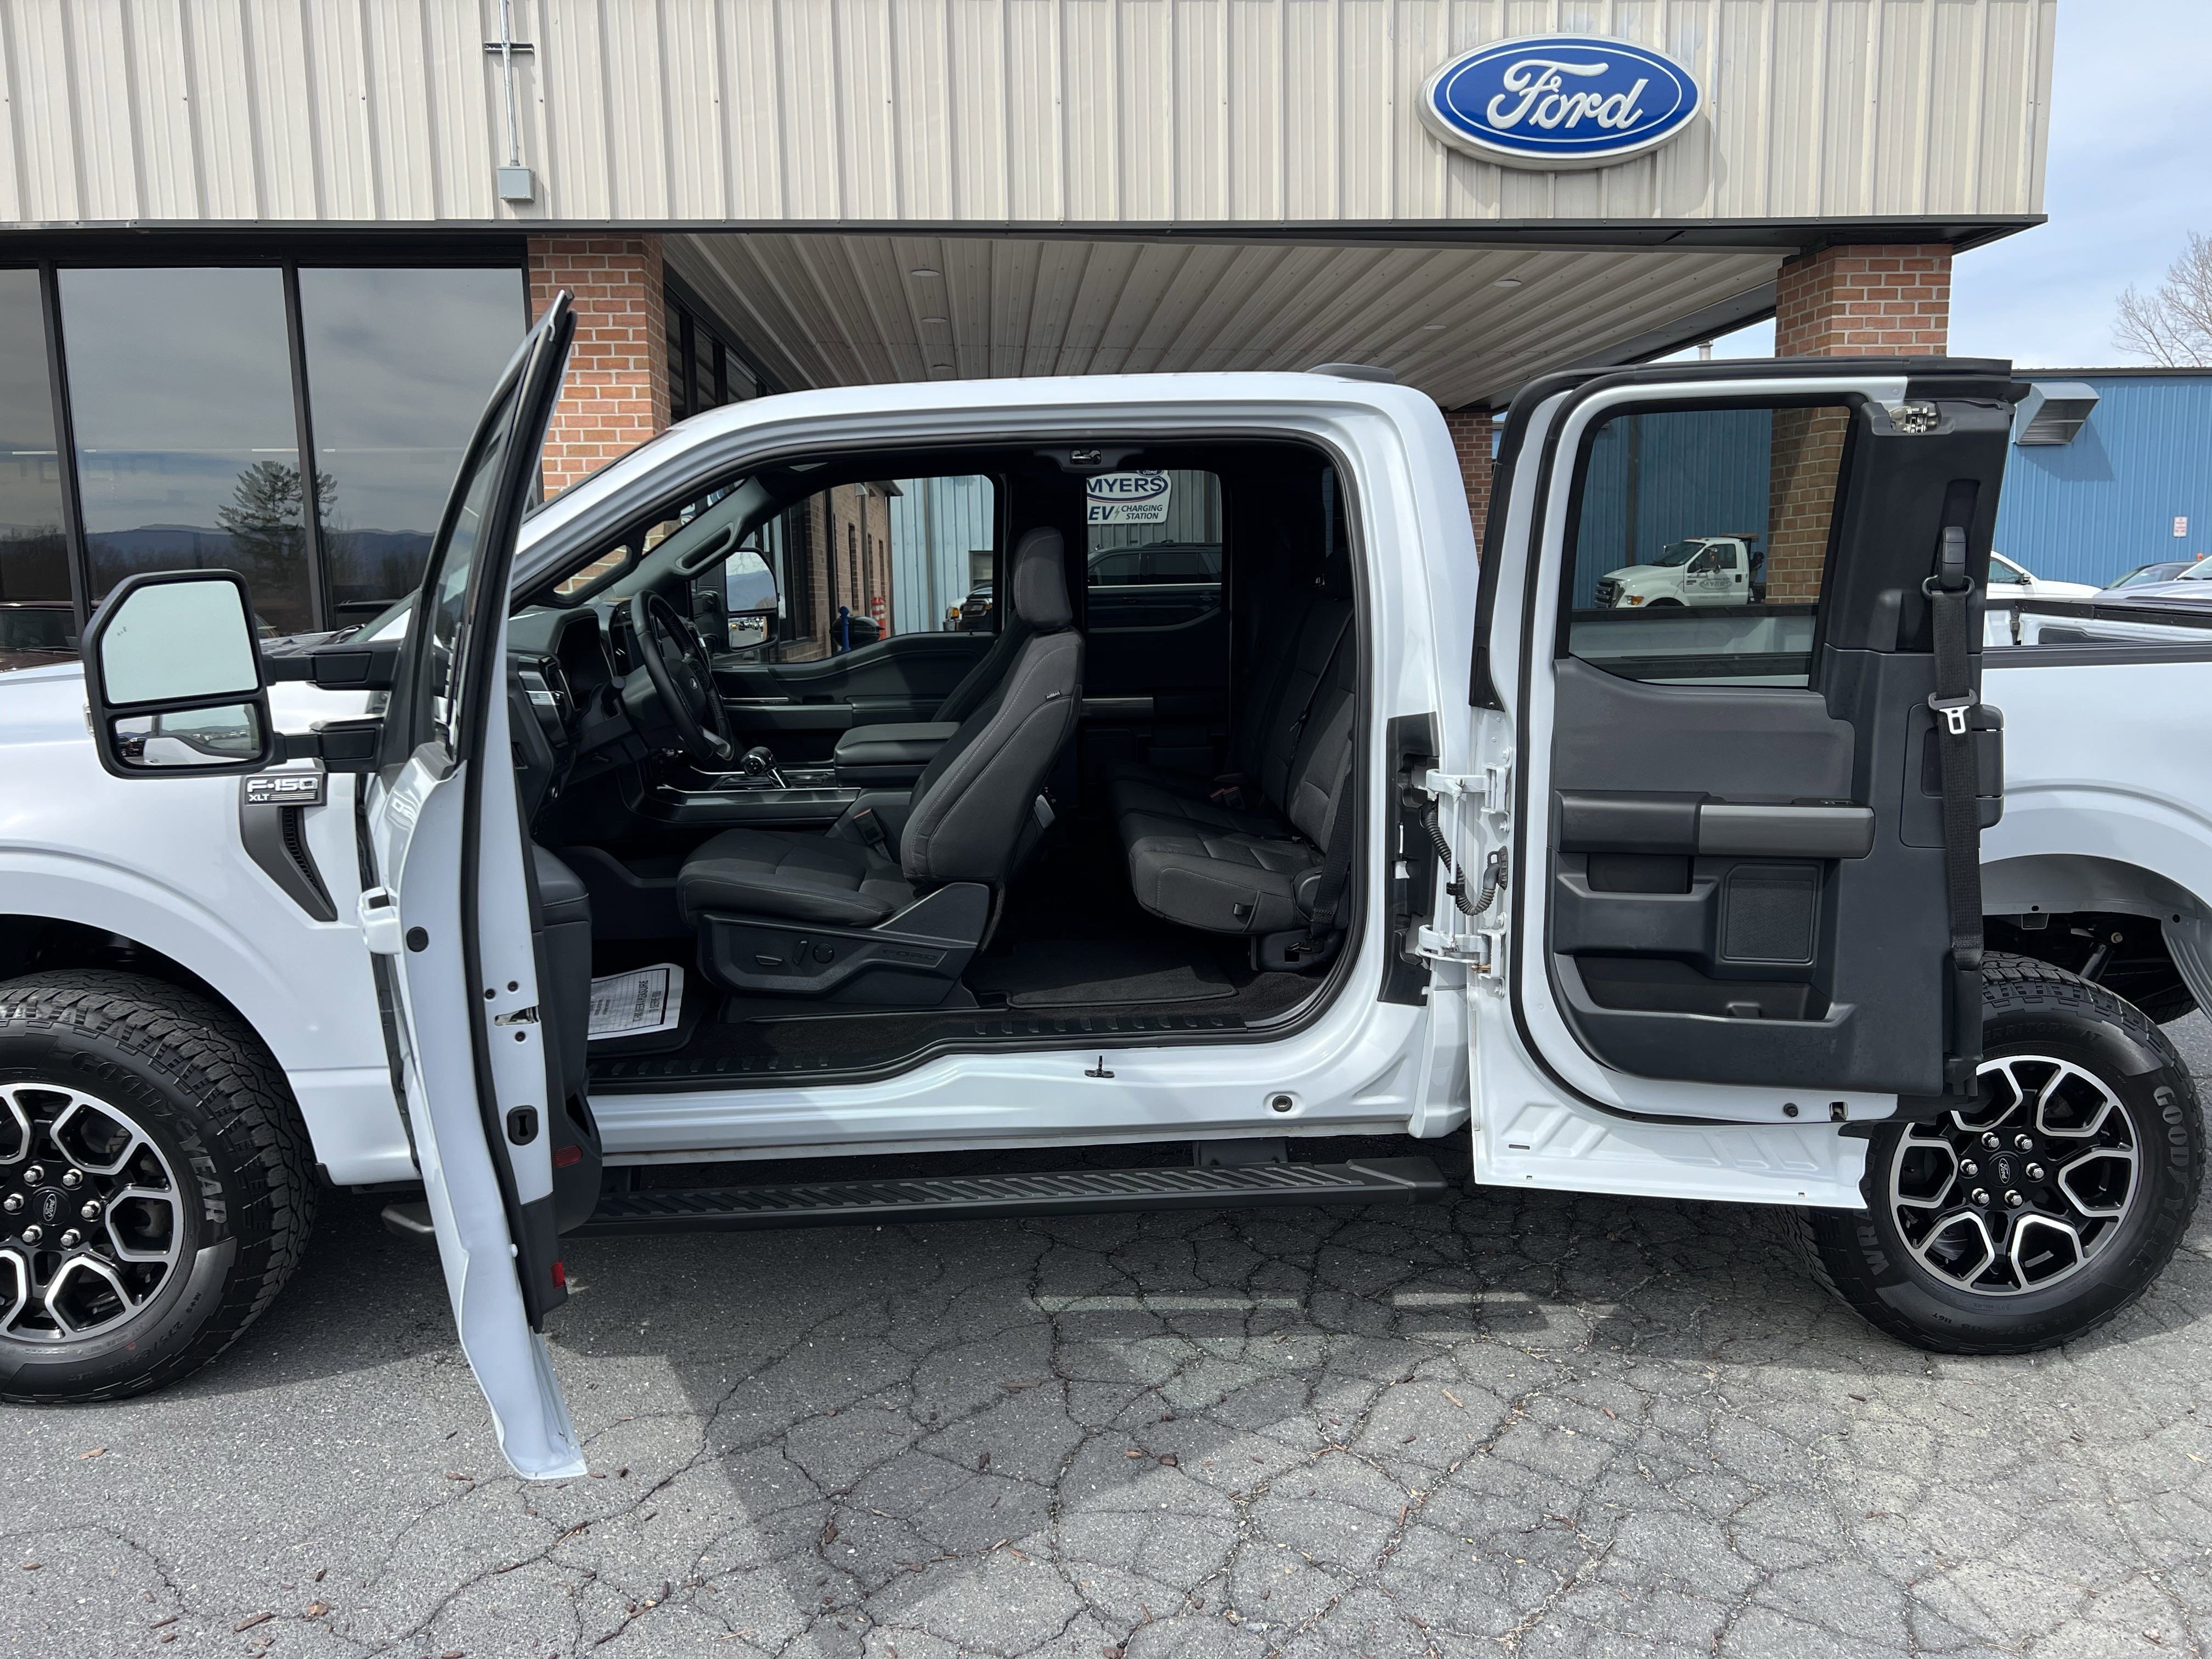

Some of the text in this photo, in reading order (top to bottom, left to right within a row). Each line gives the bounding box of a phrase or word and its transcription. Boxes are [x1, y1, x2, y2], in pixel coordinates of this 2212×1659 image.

[1486, 59, 1649, 129] Ford
[1087, 478, 1163, 493] MYERS
[1088, 506, 1114, 521] EV
[1121, 504, 1163, 512] CHARGING
[1126, 512, 1159, 520] STATION
[247, 777, 318, 793] F-150
[249, 793, 270, 802] XLT
[882, 948, 938, 960] FORD
[1983, 1022, 2073, 1041] ERRITORY
[71, 1051, 228, 1224] GOODYEAR
[2129, 1085, 2190, 1277] GOODYEAR
